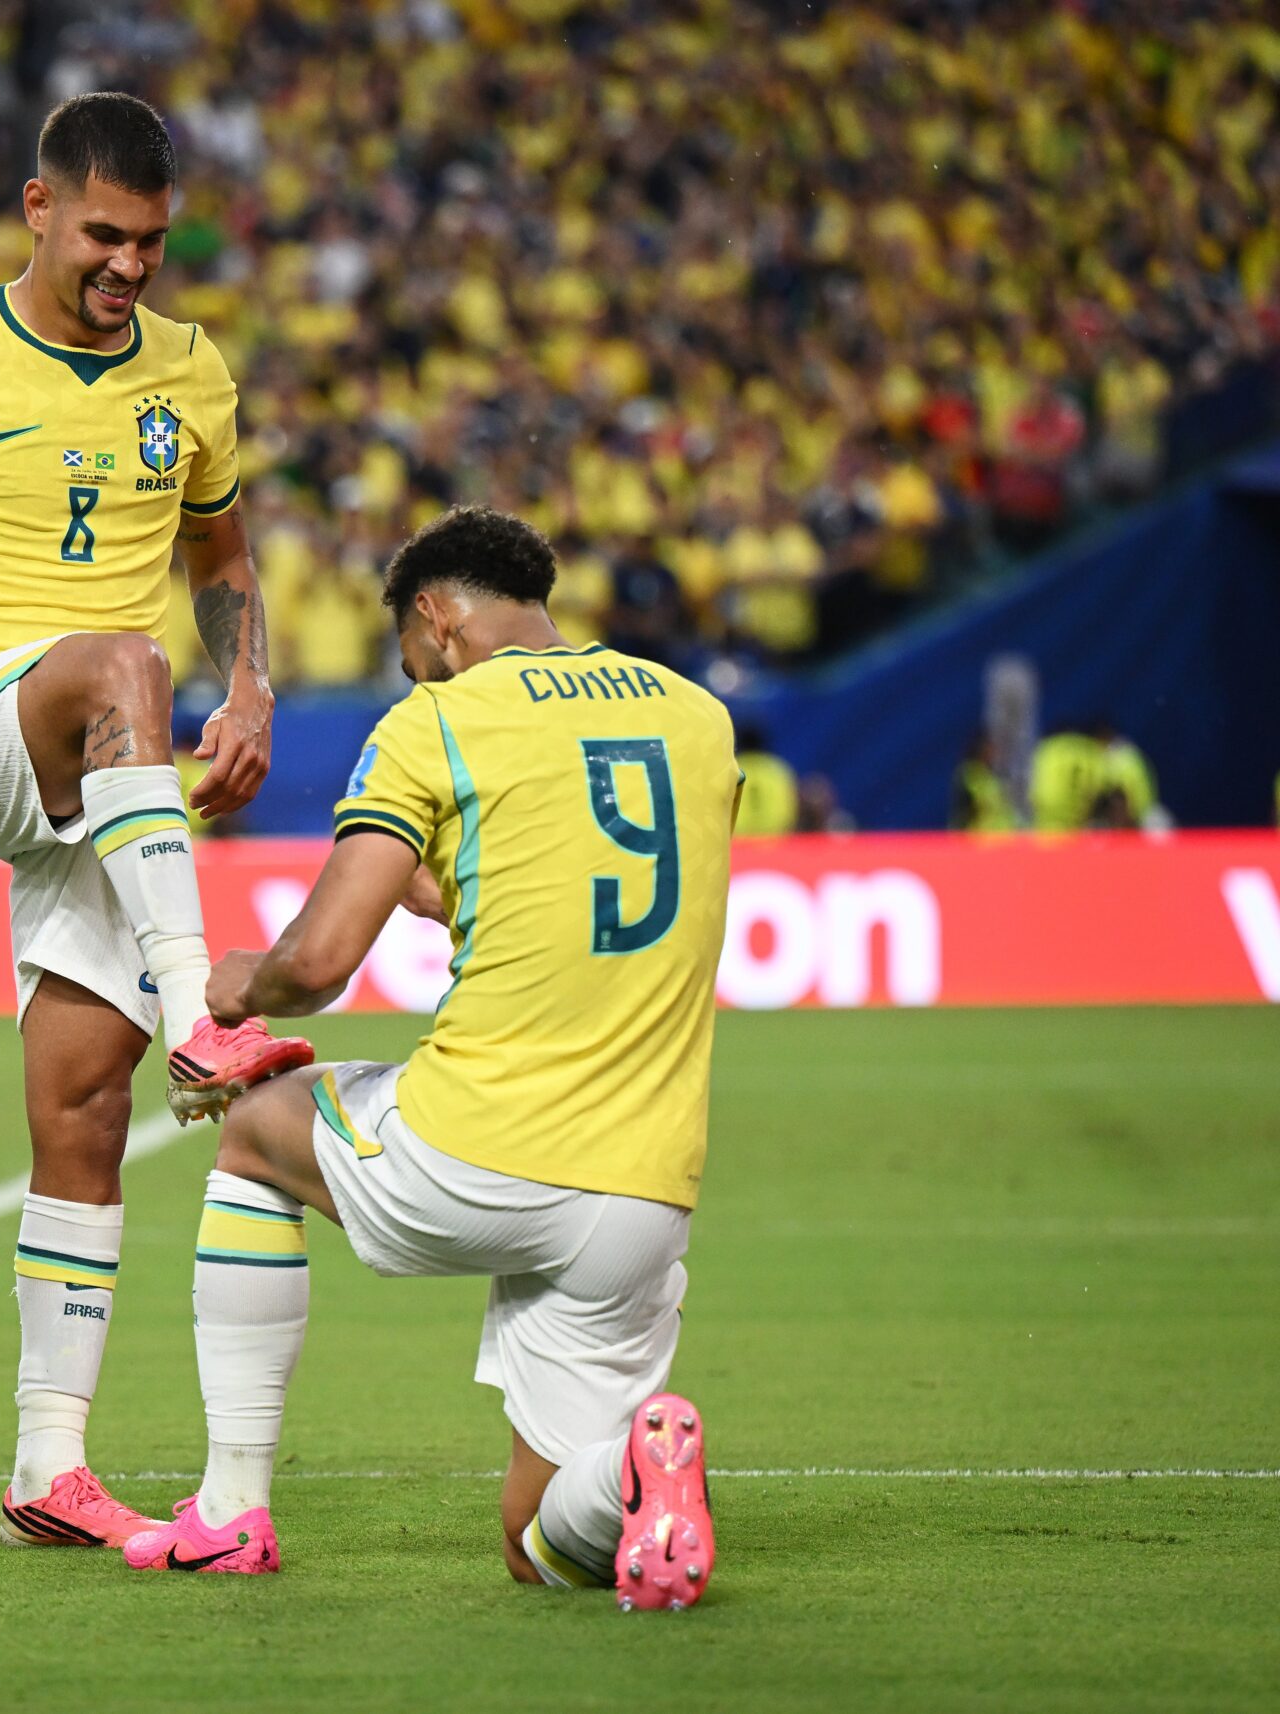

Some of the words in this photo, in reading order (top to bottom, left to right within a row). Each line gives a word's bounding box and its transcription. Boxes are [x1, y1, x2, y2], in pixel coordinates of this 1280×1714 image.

[151, 433, 168, 443] CBF
[136, 477, 178, 491] BRASIL
[60, 486, 99, 563] 8
[519, 666, 667, 703] CUNHA
[141, 841, 189, 859] BRASIL
[578, 736, 681, 956] 9
[64, 1302, 106, 1321] BRASIL
